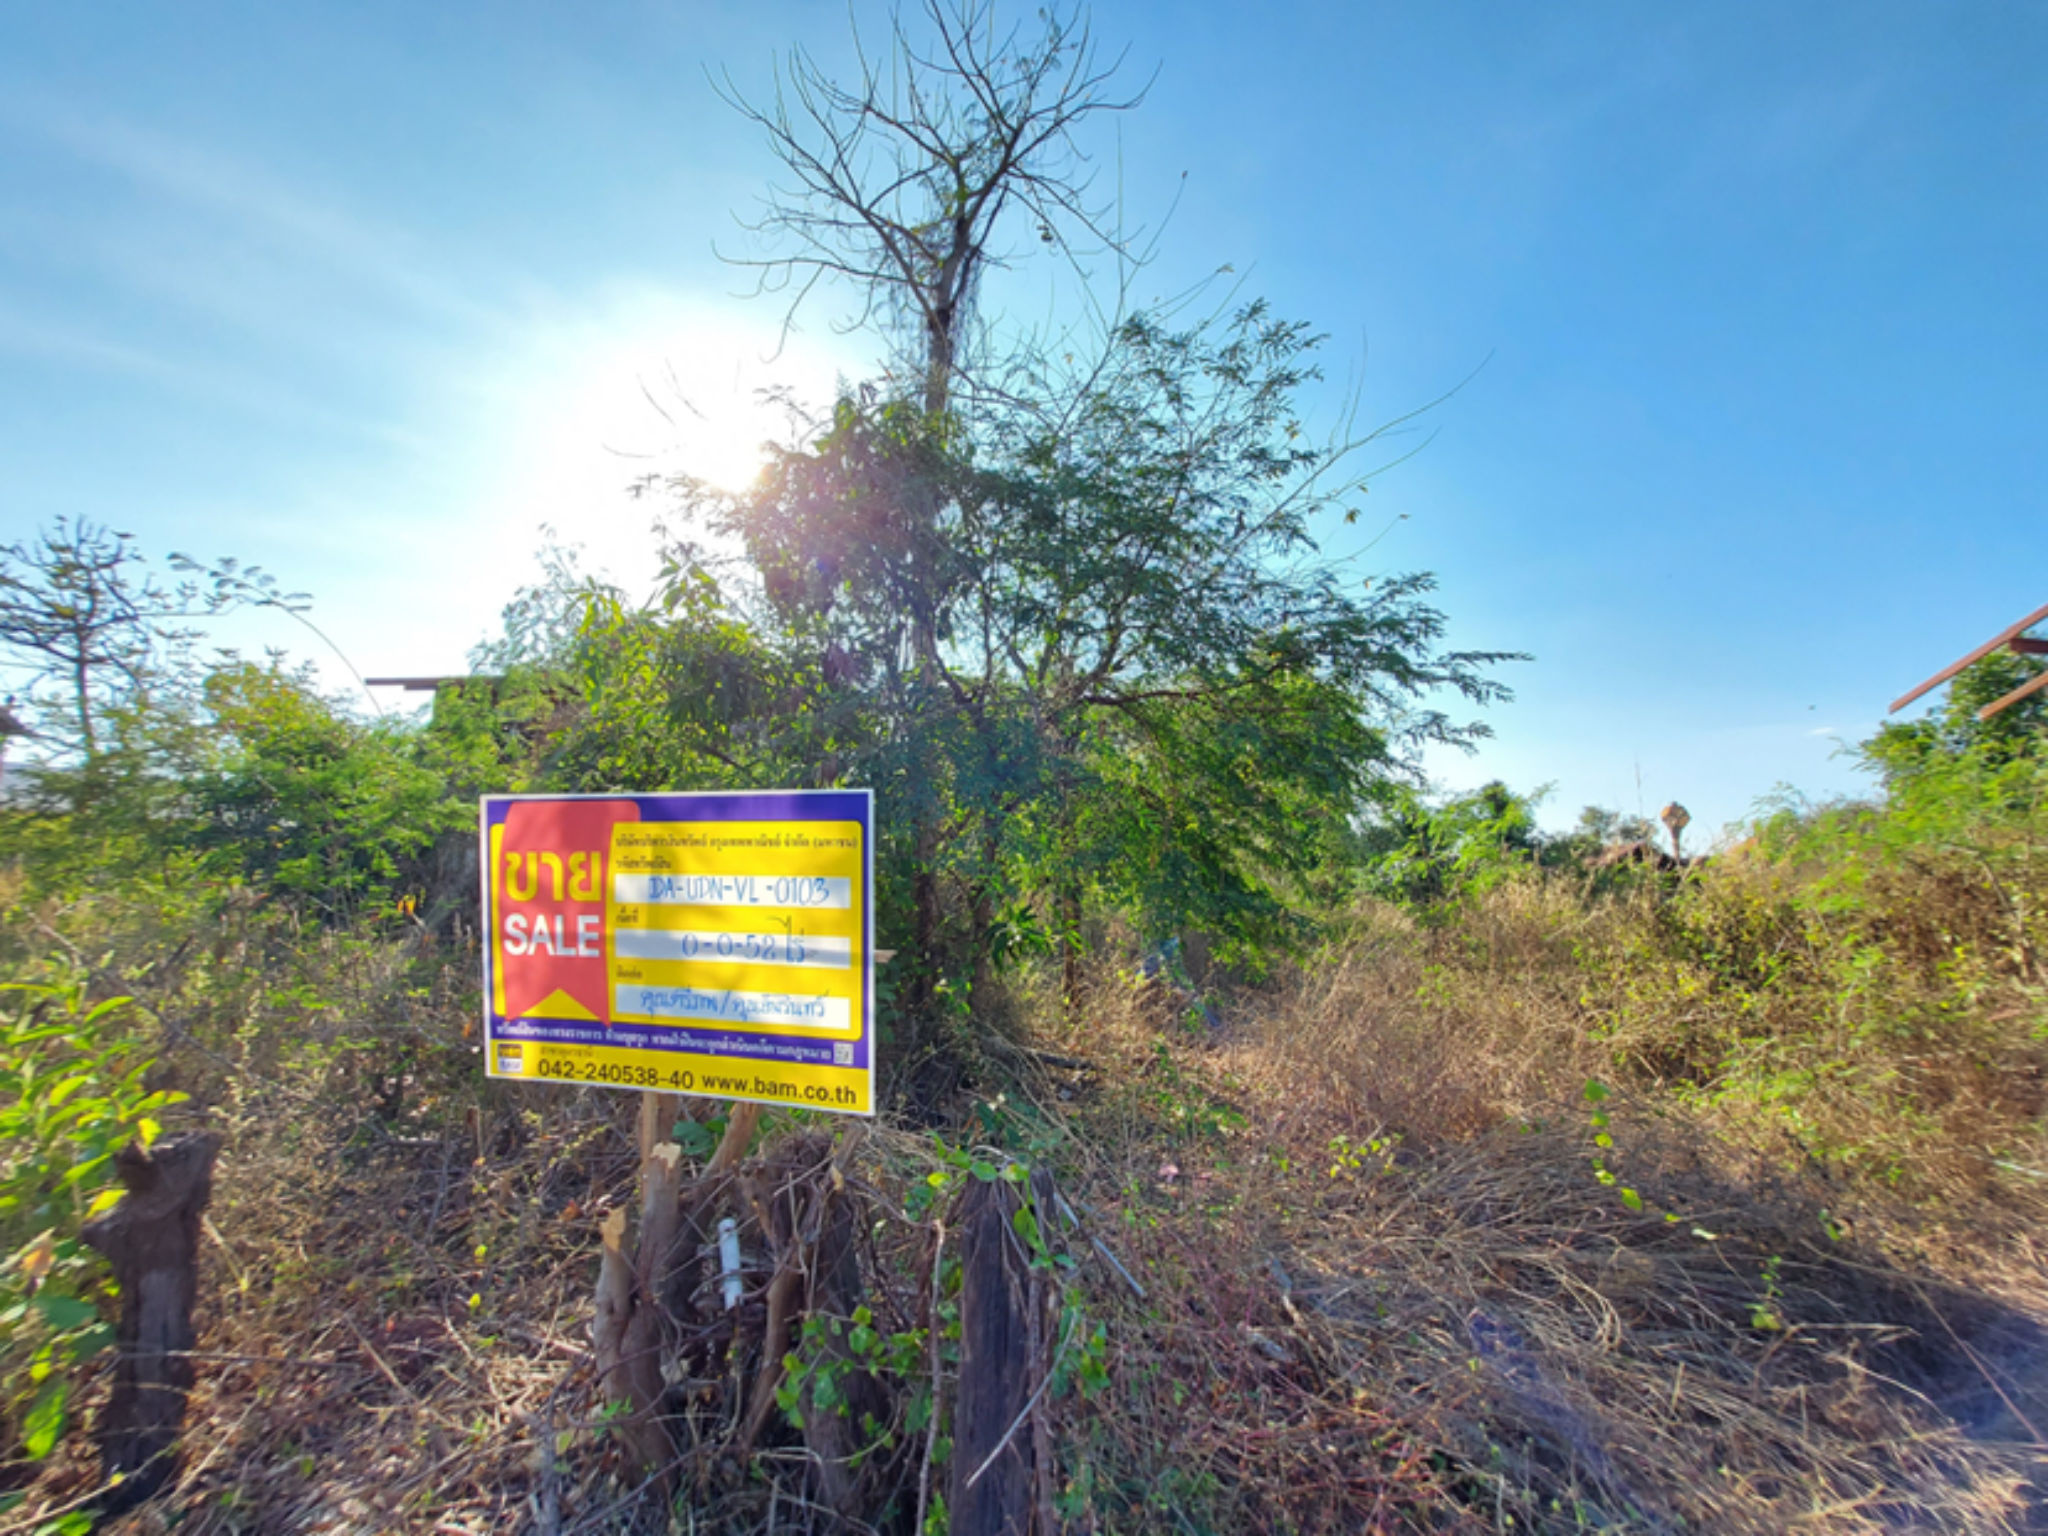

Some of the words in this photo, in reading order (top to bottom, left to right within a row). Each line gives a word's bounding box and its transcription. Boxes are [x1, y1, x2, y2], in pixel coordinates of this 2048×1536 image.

[505, 851, 602, 902] ขาย
[504, 912, 600, 958] SALE
[537, 1058, 695, 1089] 042-240538-40
[702, 1074, 857, 1104] www.bam.co.th
